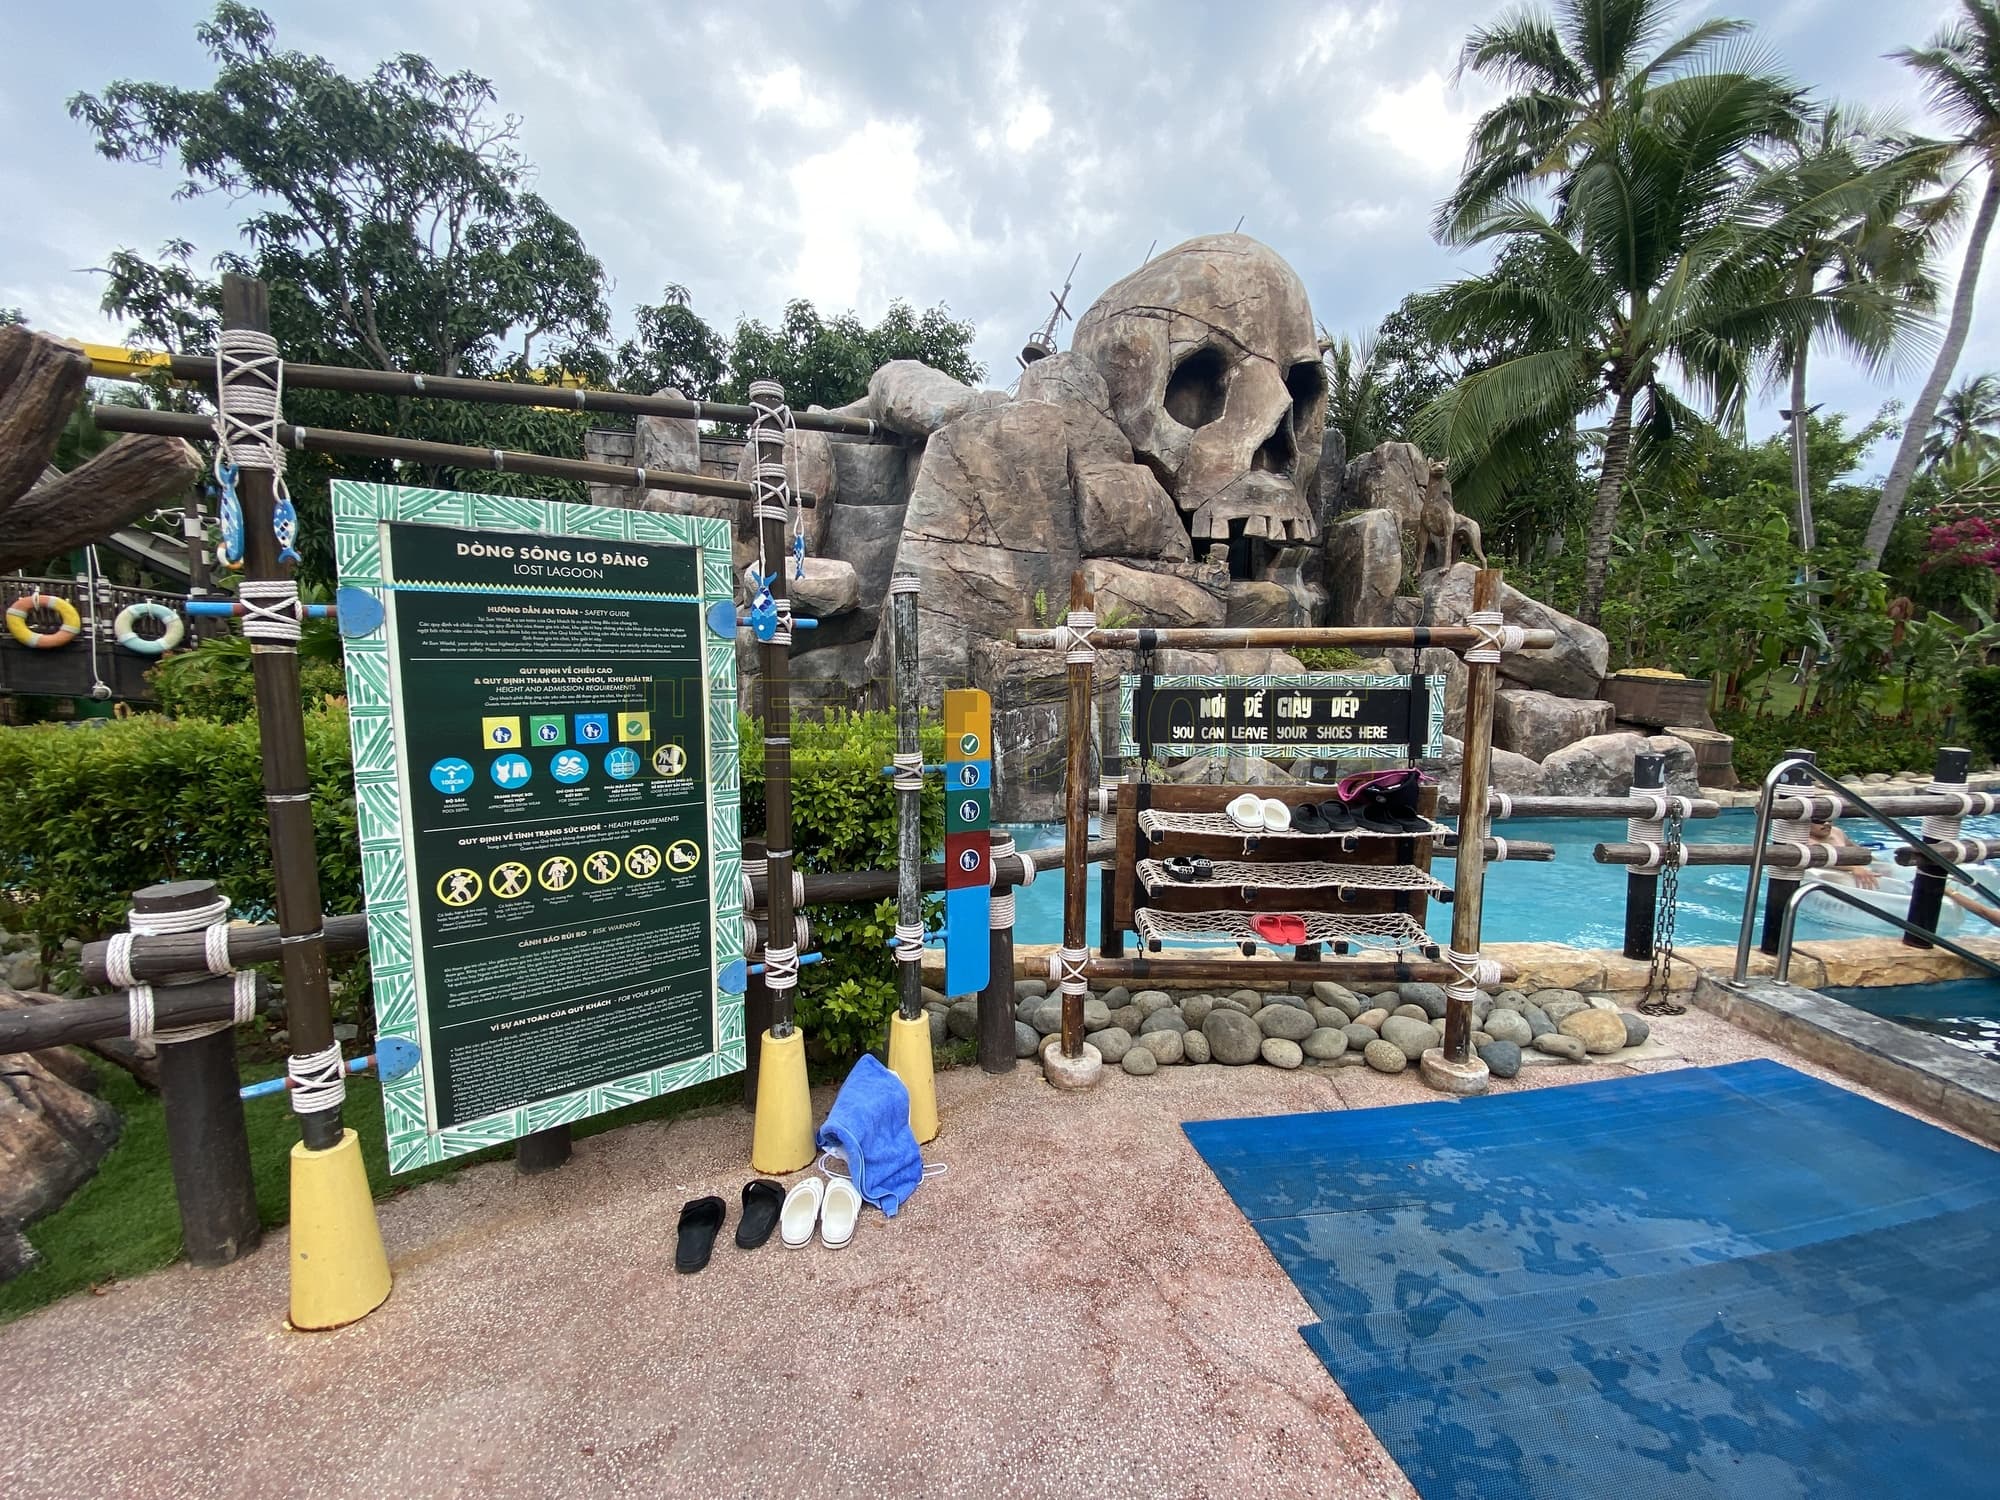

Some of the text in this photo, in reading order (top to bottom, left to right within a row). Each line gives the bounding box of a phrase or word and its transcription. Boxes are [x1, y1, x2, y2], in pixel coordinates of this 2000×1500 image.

[457, 541, 649, 567] DÒNG SÔNG LƠ ĐÃNG
[513, 563, 604, 579] LOST LAGOON
[519, 667, 538, 675] QUY
[539, 667, 560, 676] ĐỊNH
[482, 677, 501, 685] QUY
[503, 677, 525, 686] ĐỊNH
[525, 685, 542, 693] AND
[1243, 689, 1267, 718] ĐỂ
[1331, 691, 1360, 719] DÉP
[1172, 725, 1388, 740] YOU CAN LEAVE YOUR SHOES HERE
[458, 838, 478, 846] QUY
[479, 836, 501, 844] ĐỊNH
[608, 820, 632, 829] HEALTH
[633, 816, 680, 827] REQUIREMENTS
[593, 926, 607, 935] RISK
[608, 920, 640, 932] WARNING
[513, 1019, 526, 1027] AN
[527, 1013, 549, 1024] TOÀN
[586, 998, 611, 1010] KHÁCH
[618, 994, 631, 1003] FOR
[632, 990, 650, 999] YOUR
[650, 984, 672, 996] SAFETY
